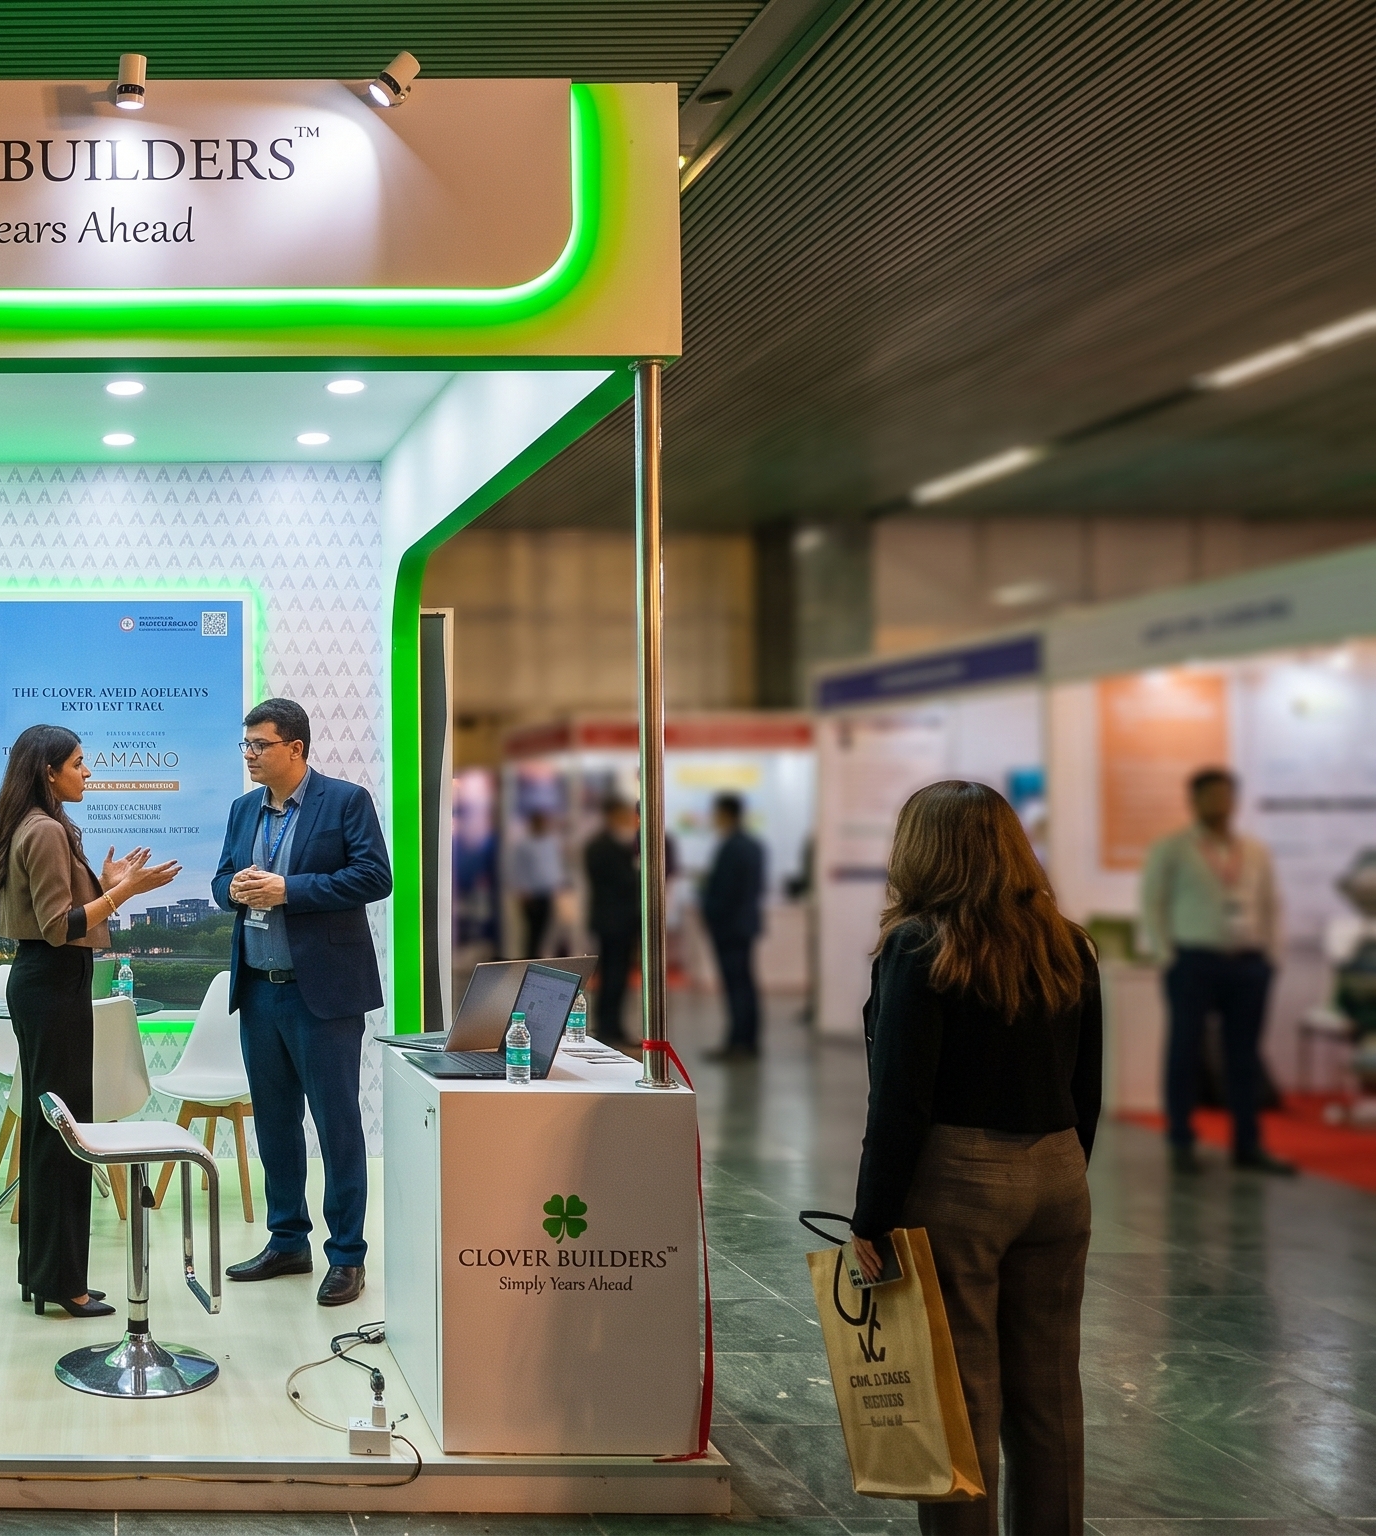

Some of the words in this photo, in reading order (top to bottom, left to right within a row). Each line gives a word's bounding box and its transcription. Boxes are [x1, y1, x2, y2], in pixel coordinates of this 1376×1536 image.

[77, 206, 195, 243] Ahead
[12, 687, 39, 698] THE
[93, 751, 180, 768] AMANO
[458, 1248, 551, 1268] CLOVER
[499, 1275, 546, 1295] Simply
[550, 1276, 585, 1291] Years
[588, 1275, 633, 1291] Ahead
